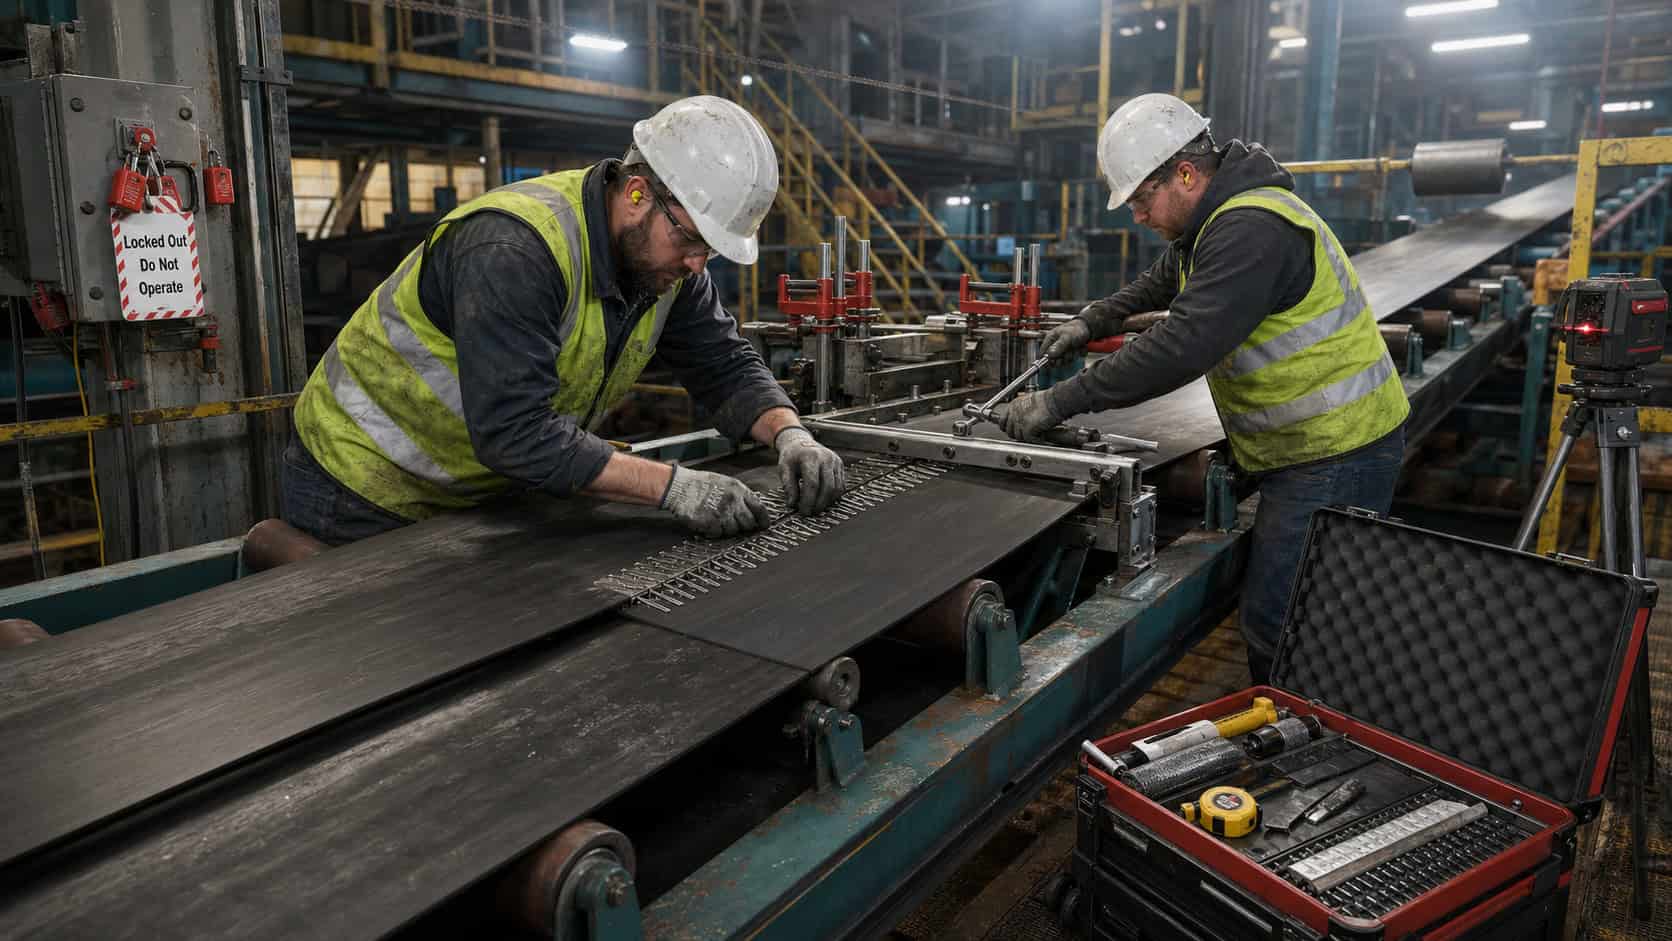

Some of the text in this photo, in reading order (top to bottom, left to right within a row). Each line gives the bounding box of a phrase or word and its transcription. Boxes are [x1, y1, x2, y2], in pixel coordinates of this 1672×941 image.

[124, 234, 187, 249] Locked Out
[140, 258, 179, 272] Do Not
[139, 281, 184, 298] Operate
